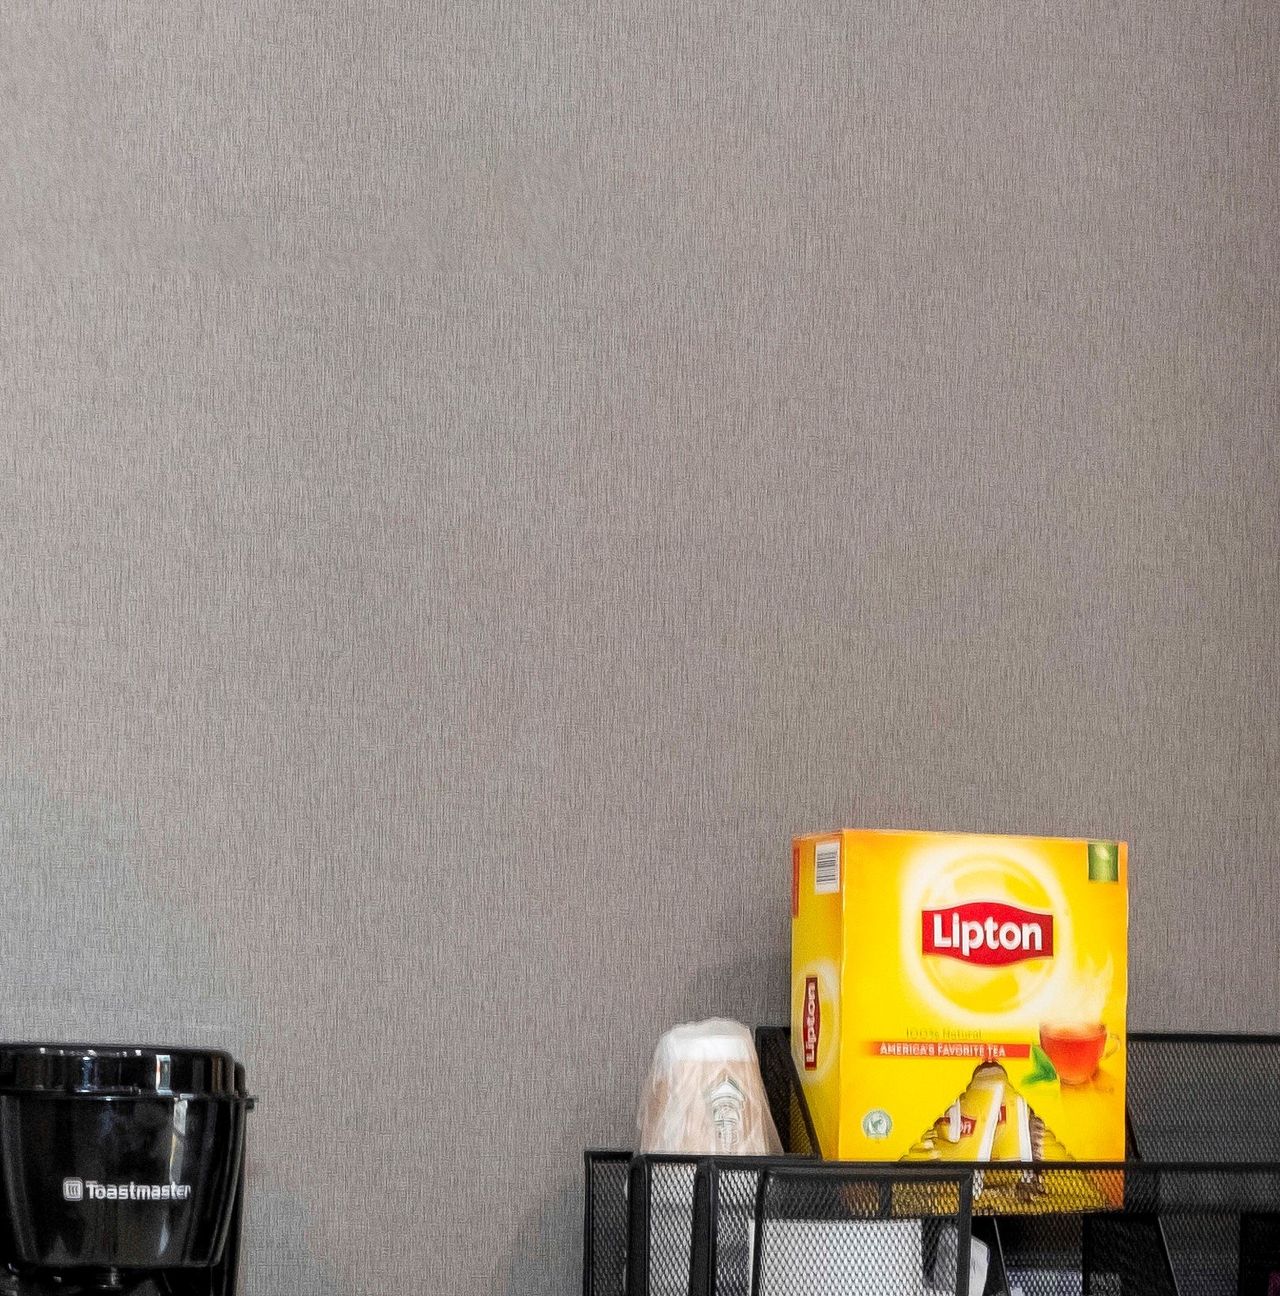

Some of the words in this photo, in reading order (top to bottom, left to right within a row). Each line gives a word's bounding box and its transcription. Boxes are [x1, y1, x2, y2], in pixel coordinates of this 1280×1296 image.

[933, 911, 1042, 957] Lipton
[806, 982, 817, 1063] Lipton
[906, 1027, 939, 1041] 100%
[943, 1030, 982, 1041] Natural
[880, 1042, 935, 1056] AMERICA'S
[937, 1044, 984, 1056] FAVORITE
[987, 1046, 1006, 1057] TEA
[85, 1180, 191, 1200] Toastmaster
